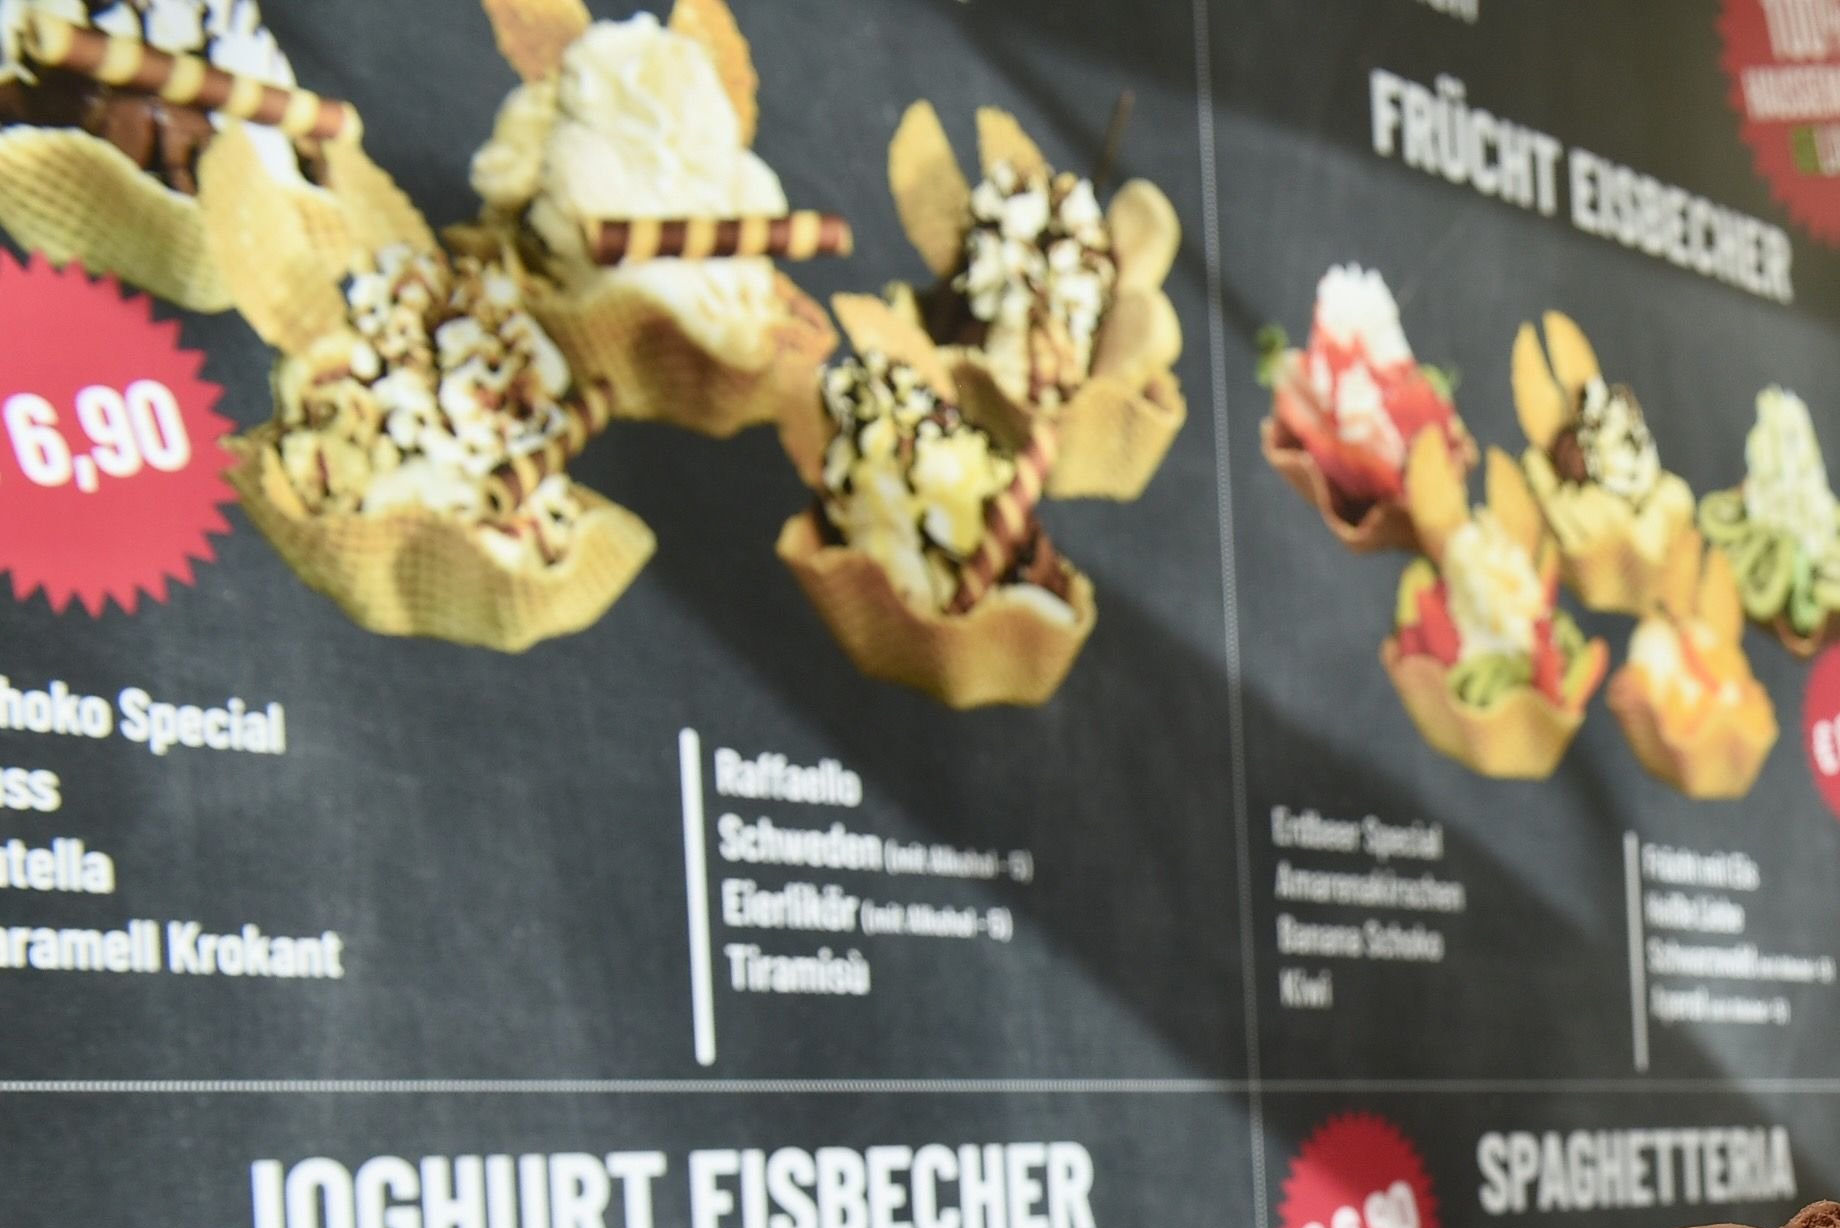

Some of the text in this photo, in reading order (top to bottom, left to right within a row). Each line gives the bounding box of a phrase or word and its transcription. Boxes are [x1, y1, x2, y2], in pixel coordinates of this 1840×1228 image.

[1369, 67, 1794, 306] FRÜCHT EISBECHER
[117, 686, 287, 756] Special
[0, 766, 62, 813] ss
[165, 920, 344, 979] Krokant
[1476, 1125, 1797, 1217] SPAGHETTERIA
